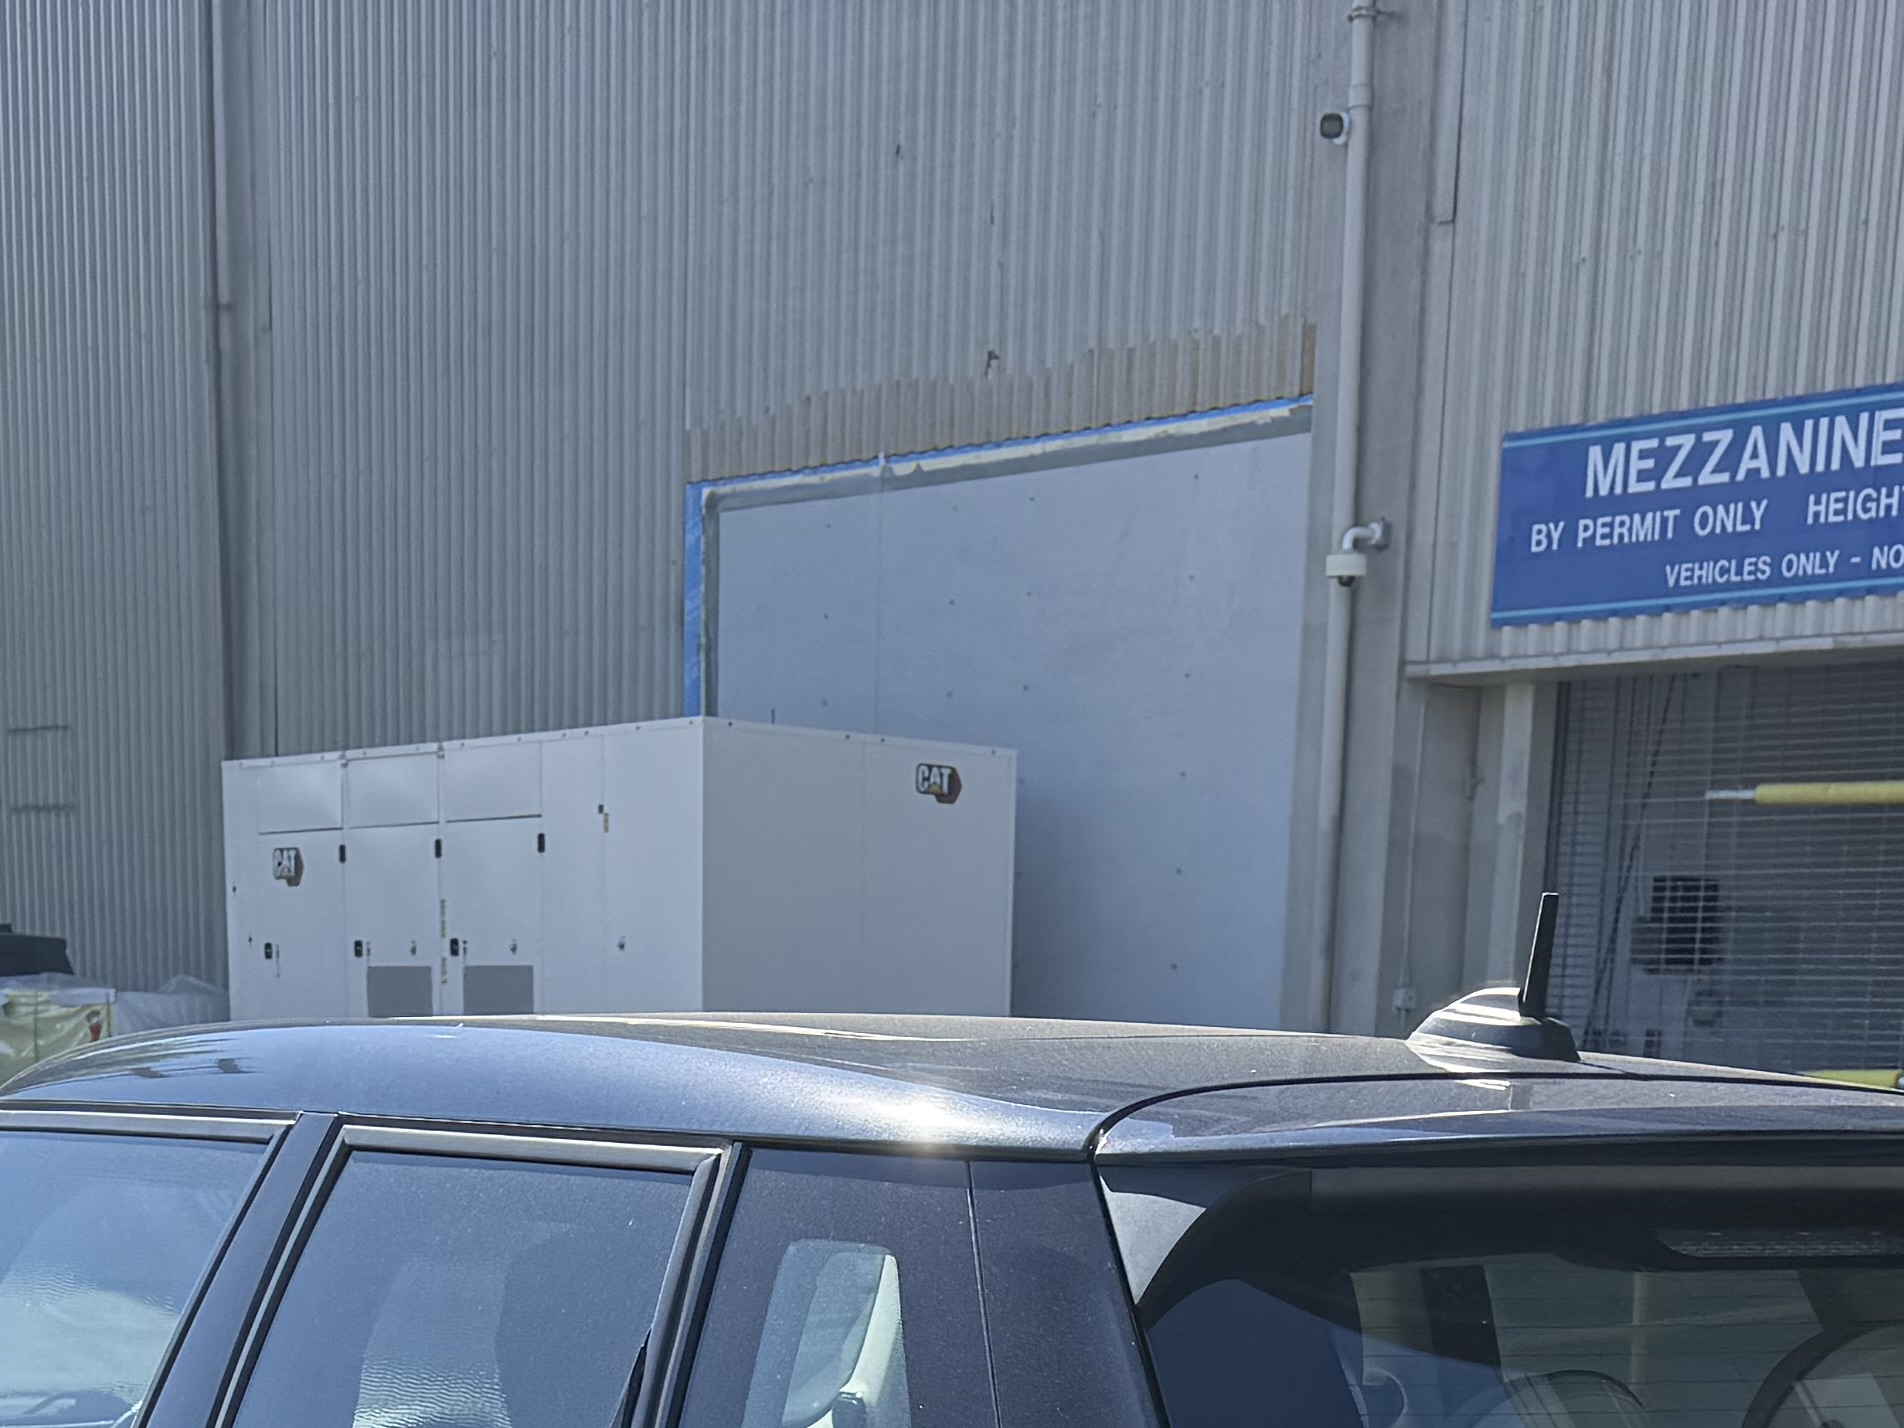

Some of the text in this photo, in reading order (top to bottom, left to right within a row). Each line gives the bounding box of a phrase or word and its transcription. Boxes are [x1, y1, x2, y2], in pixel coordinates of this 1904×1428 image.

[1531, 522, 1565, 553] BY
[1577, 510, 1680, 548] PERMIT
[1694, 500, 1768, 536] ONLY
[1665, 554, 1771, 587] VEHICLES
[1781, 550, 1840, 577] ONLY
[918, 765, 952, 795] CAT
